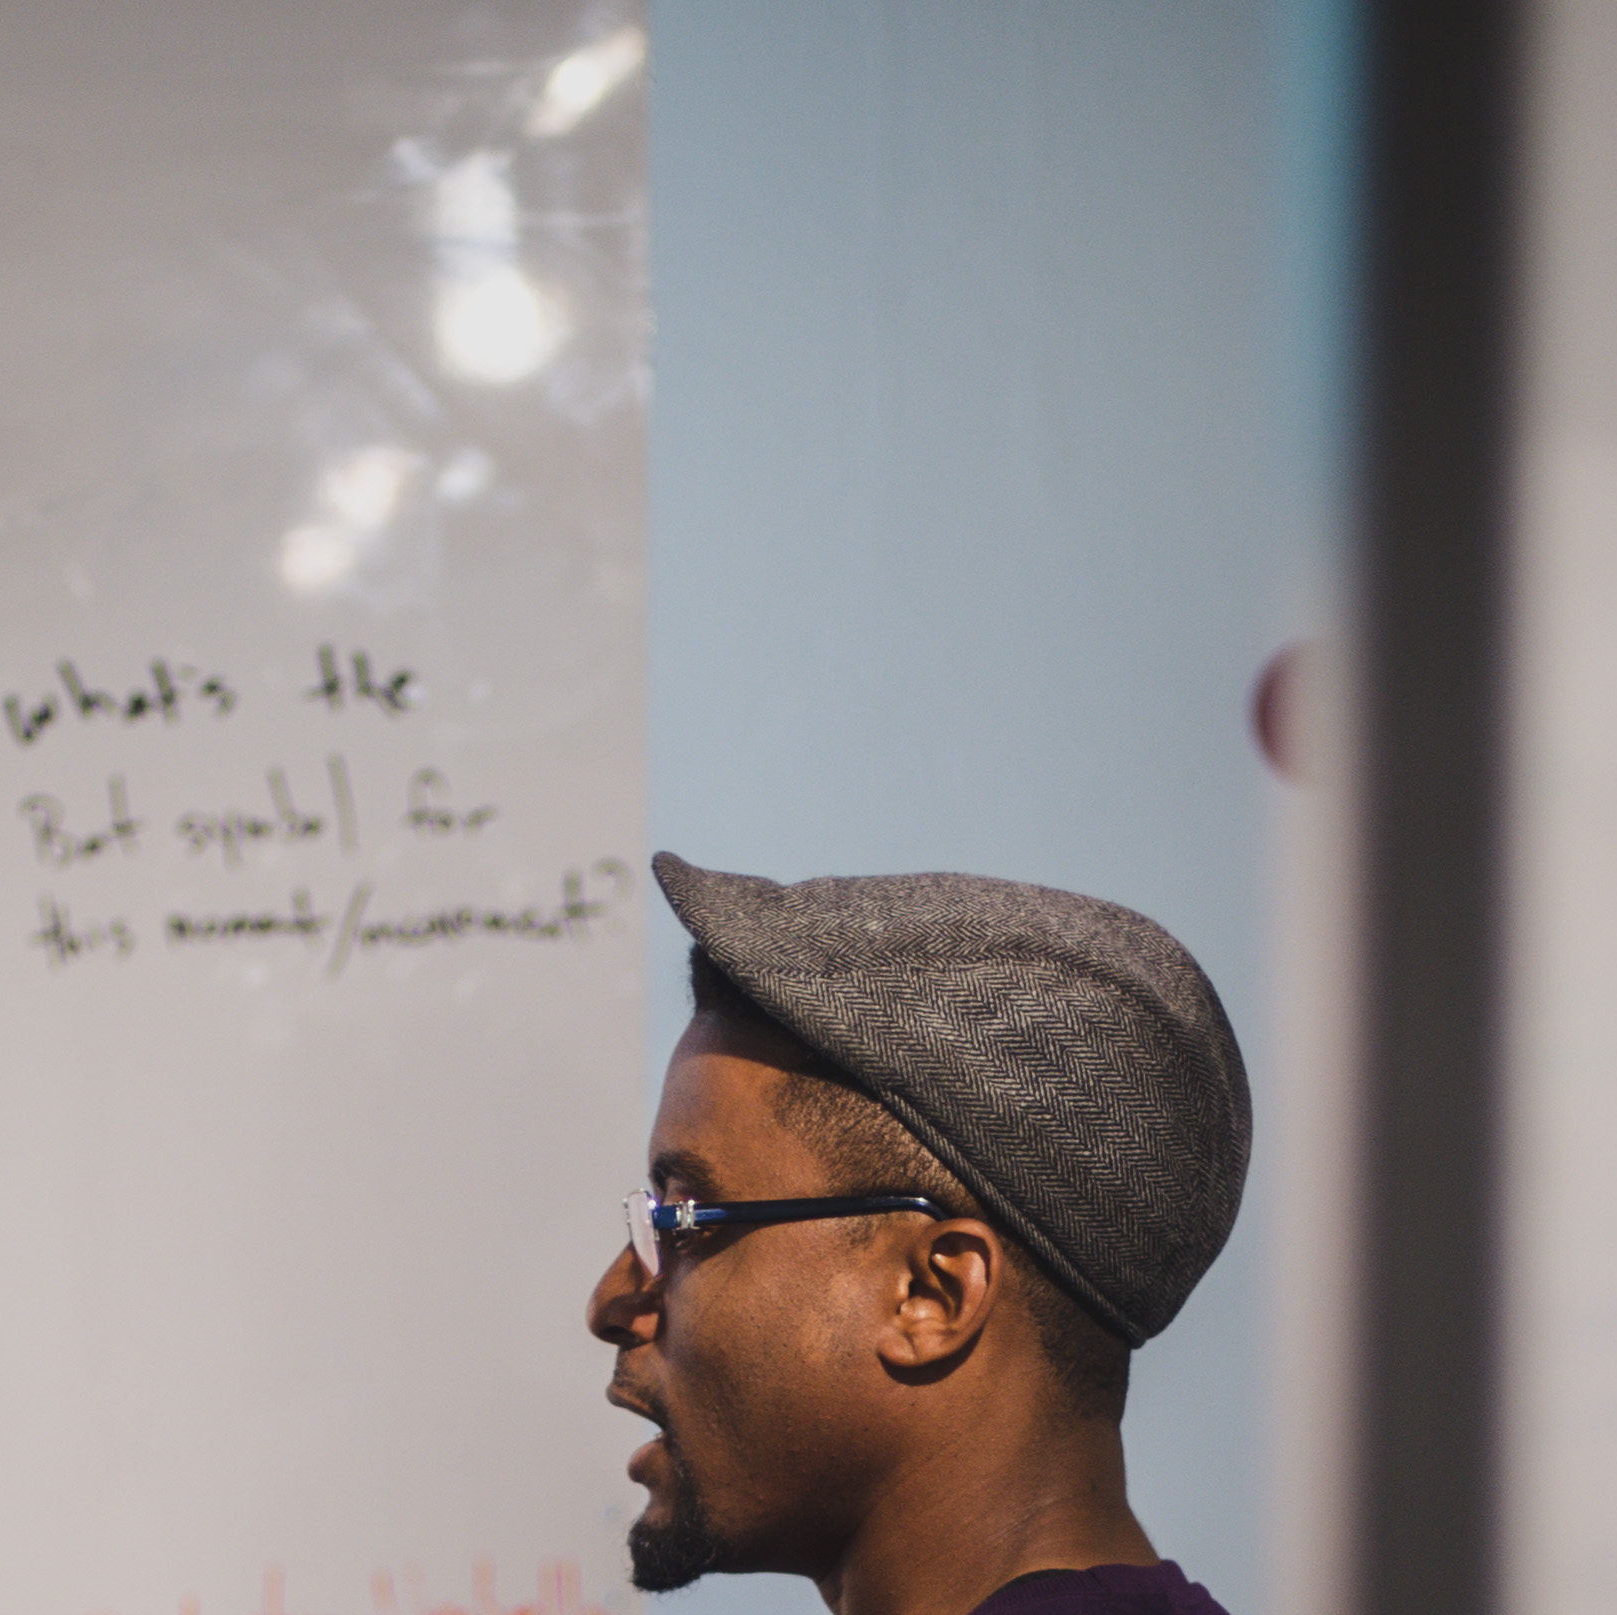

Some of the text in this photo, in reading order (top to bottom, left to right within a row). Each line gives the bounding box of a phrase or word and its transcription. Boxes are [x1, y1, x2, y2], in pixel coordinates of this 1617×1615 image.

[304, 642, 414, 716] the
[400, 764, 498, 836] for
[32, 893, 136, 975] this
